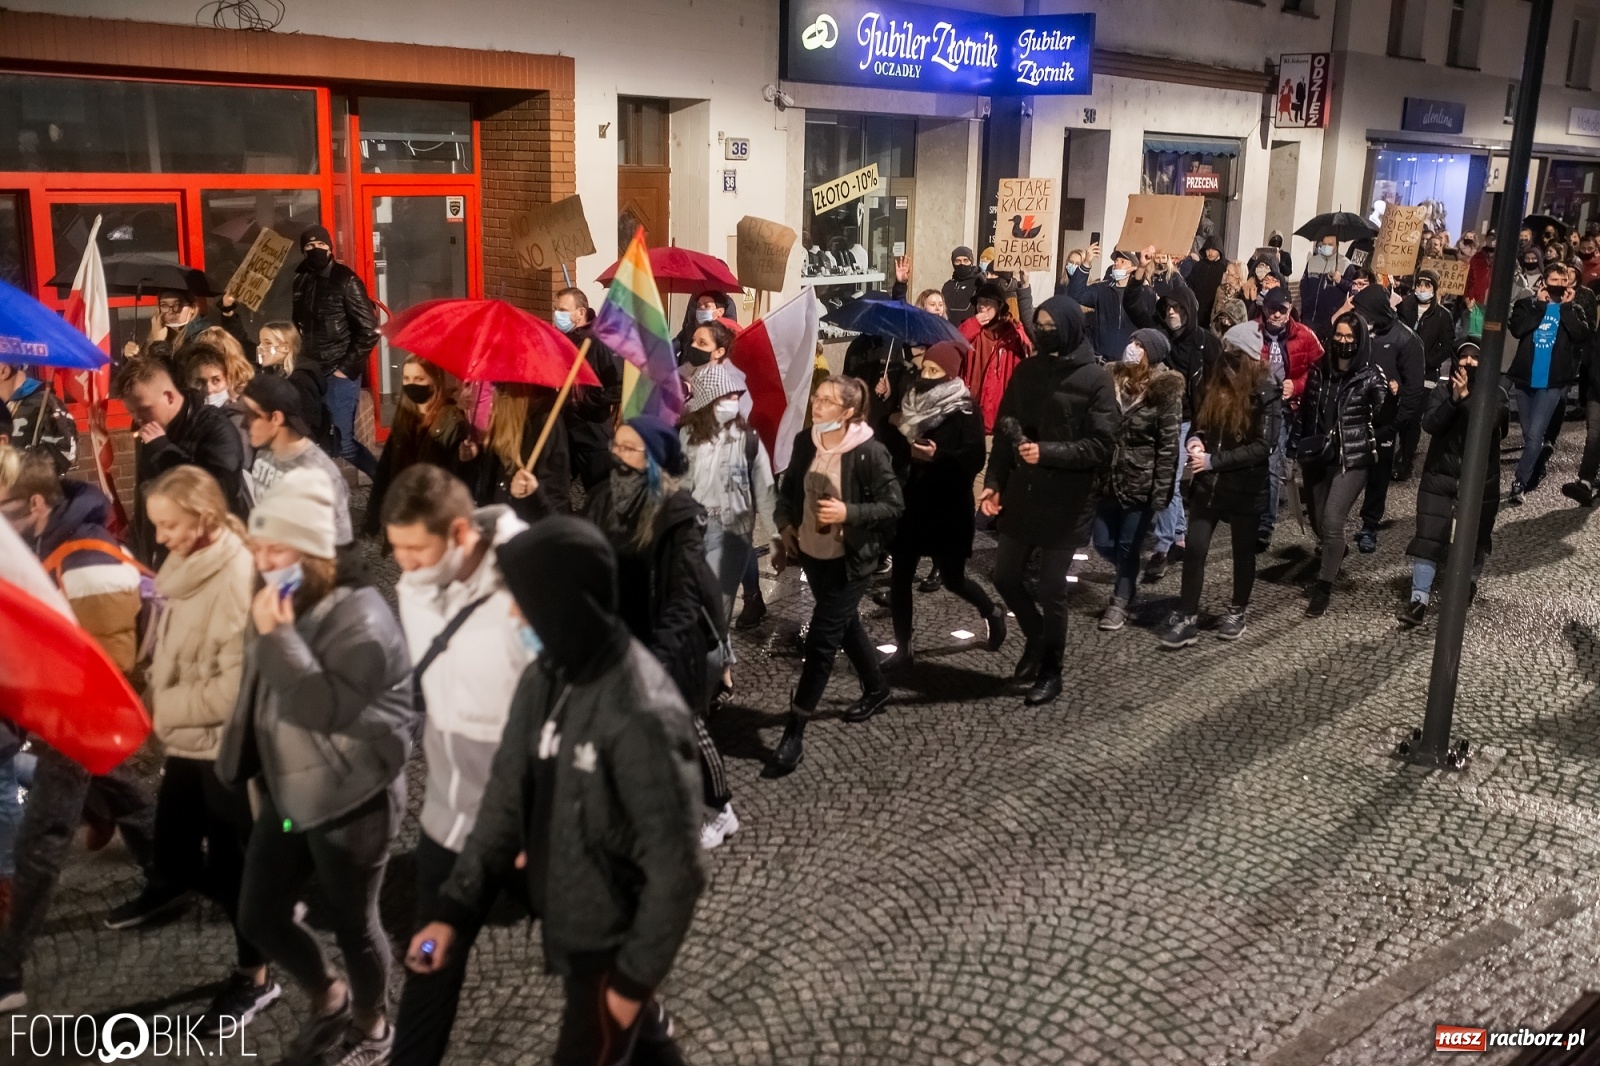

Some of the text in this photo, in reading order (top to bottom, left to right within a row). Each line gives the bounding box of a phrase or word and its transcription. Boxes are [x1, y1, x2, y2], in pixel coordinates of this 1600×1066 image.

[857, 12, 998, 72] Jubiler Złotnik
[1018, 29, 1075, 59] Jubiler
[873, 61, 922, 79] OCZADŁY
[1016, 60, 1075, 86] Złotnik
[732, 142, 748, 155] 36
[725, 177, 735, 188] 36
[814, 168, 878, 210] ZŁOTO -10%
[1003, 180, 1051, 197] STARE
[1186, 176, 1218, 189] PRZECENA
[1001, 197, 1048, 213] KACZKI
[515, 243, 544, 274] NO
